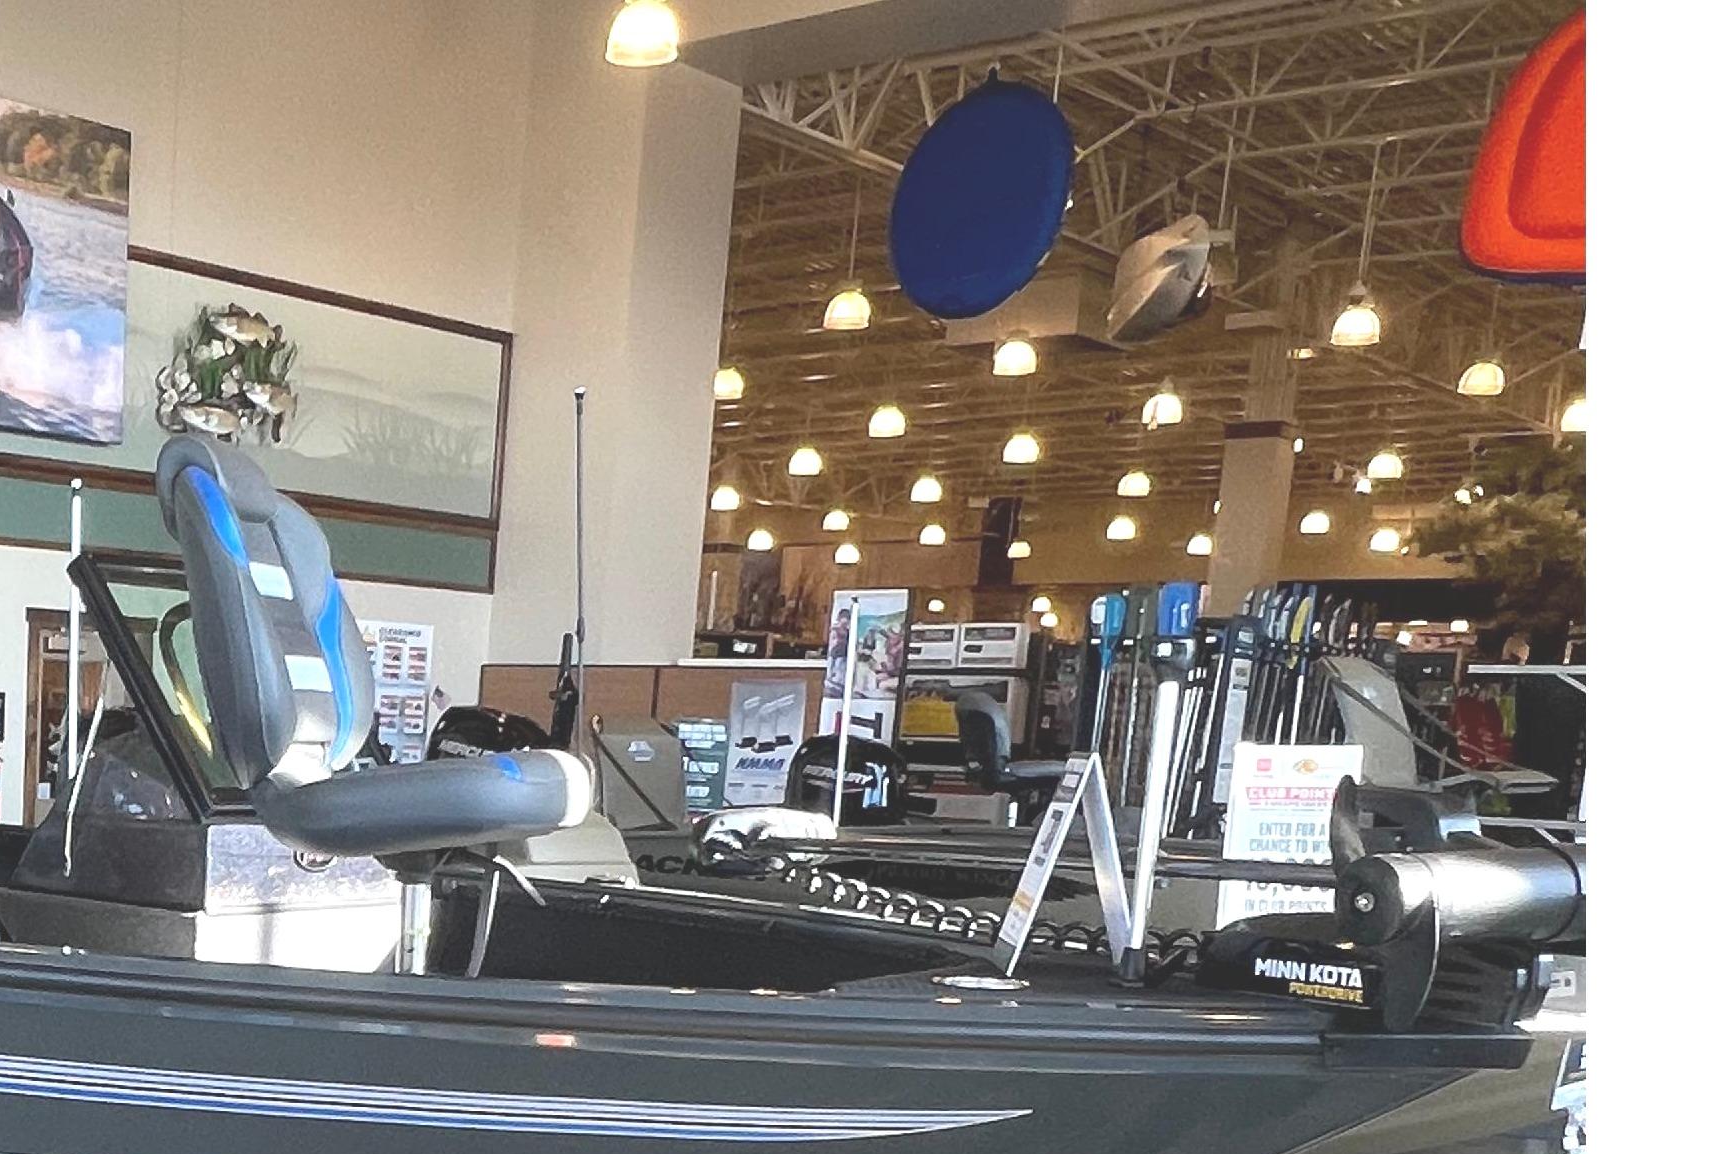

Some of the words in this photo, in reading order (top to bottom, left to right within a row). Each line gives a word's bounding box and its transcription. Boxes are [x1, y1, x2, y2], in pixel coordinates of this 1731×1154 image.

[1259, 822, 1292, 837] ENTER
[1295, 822, 1315, 837] FOR
[1319, 823, 1326, 836] A
[1249, 838, 1293, 854] CHANCE
[1296, 839, 1309, 854] TO
[1254, 957, 1306, 981] MINN
[1309, 963, 1363, 988] KOTA
